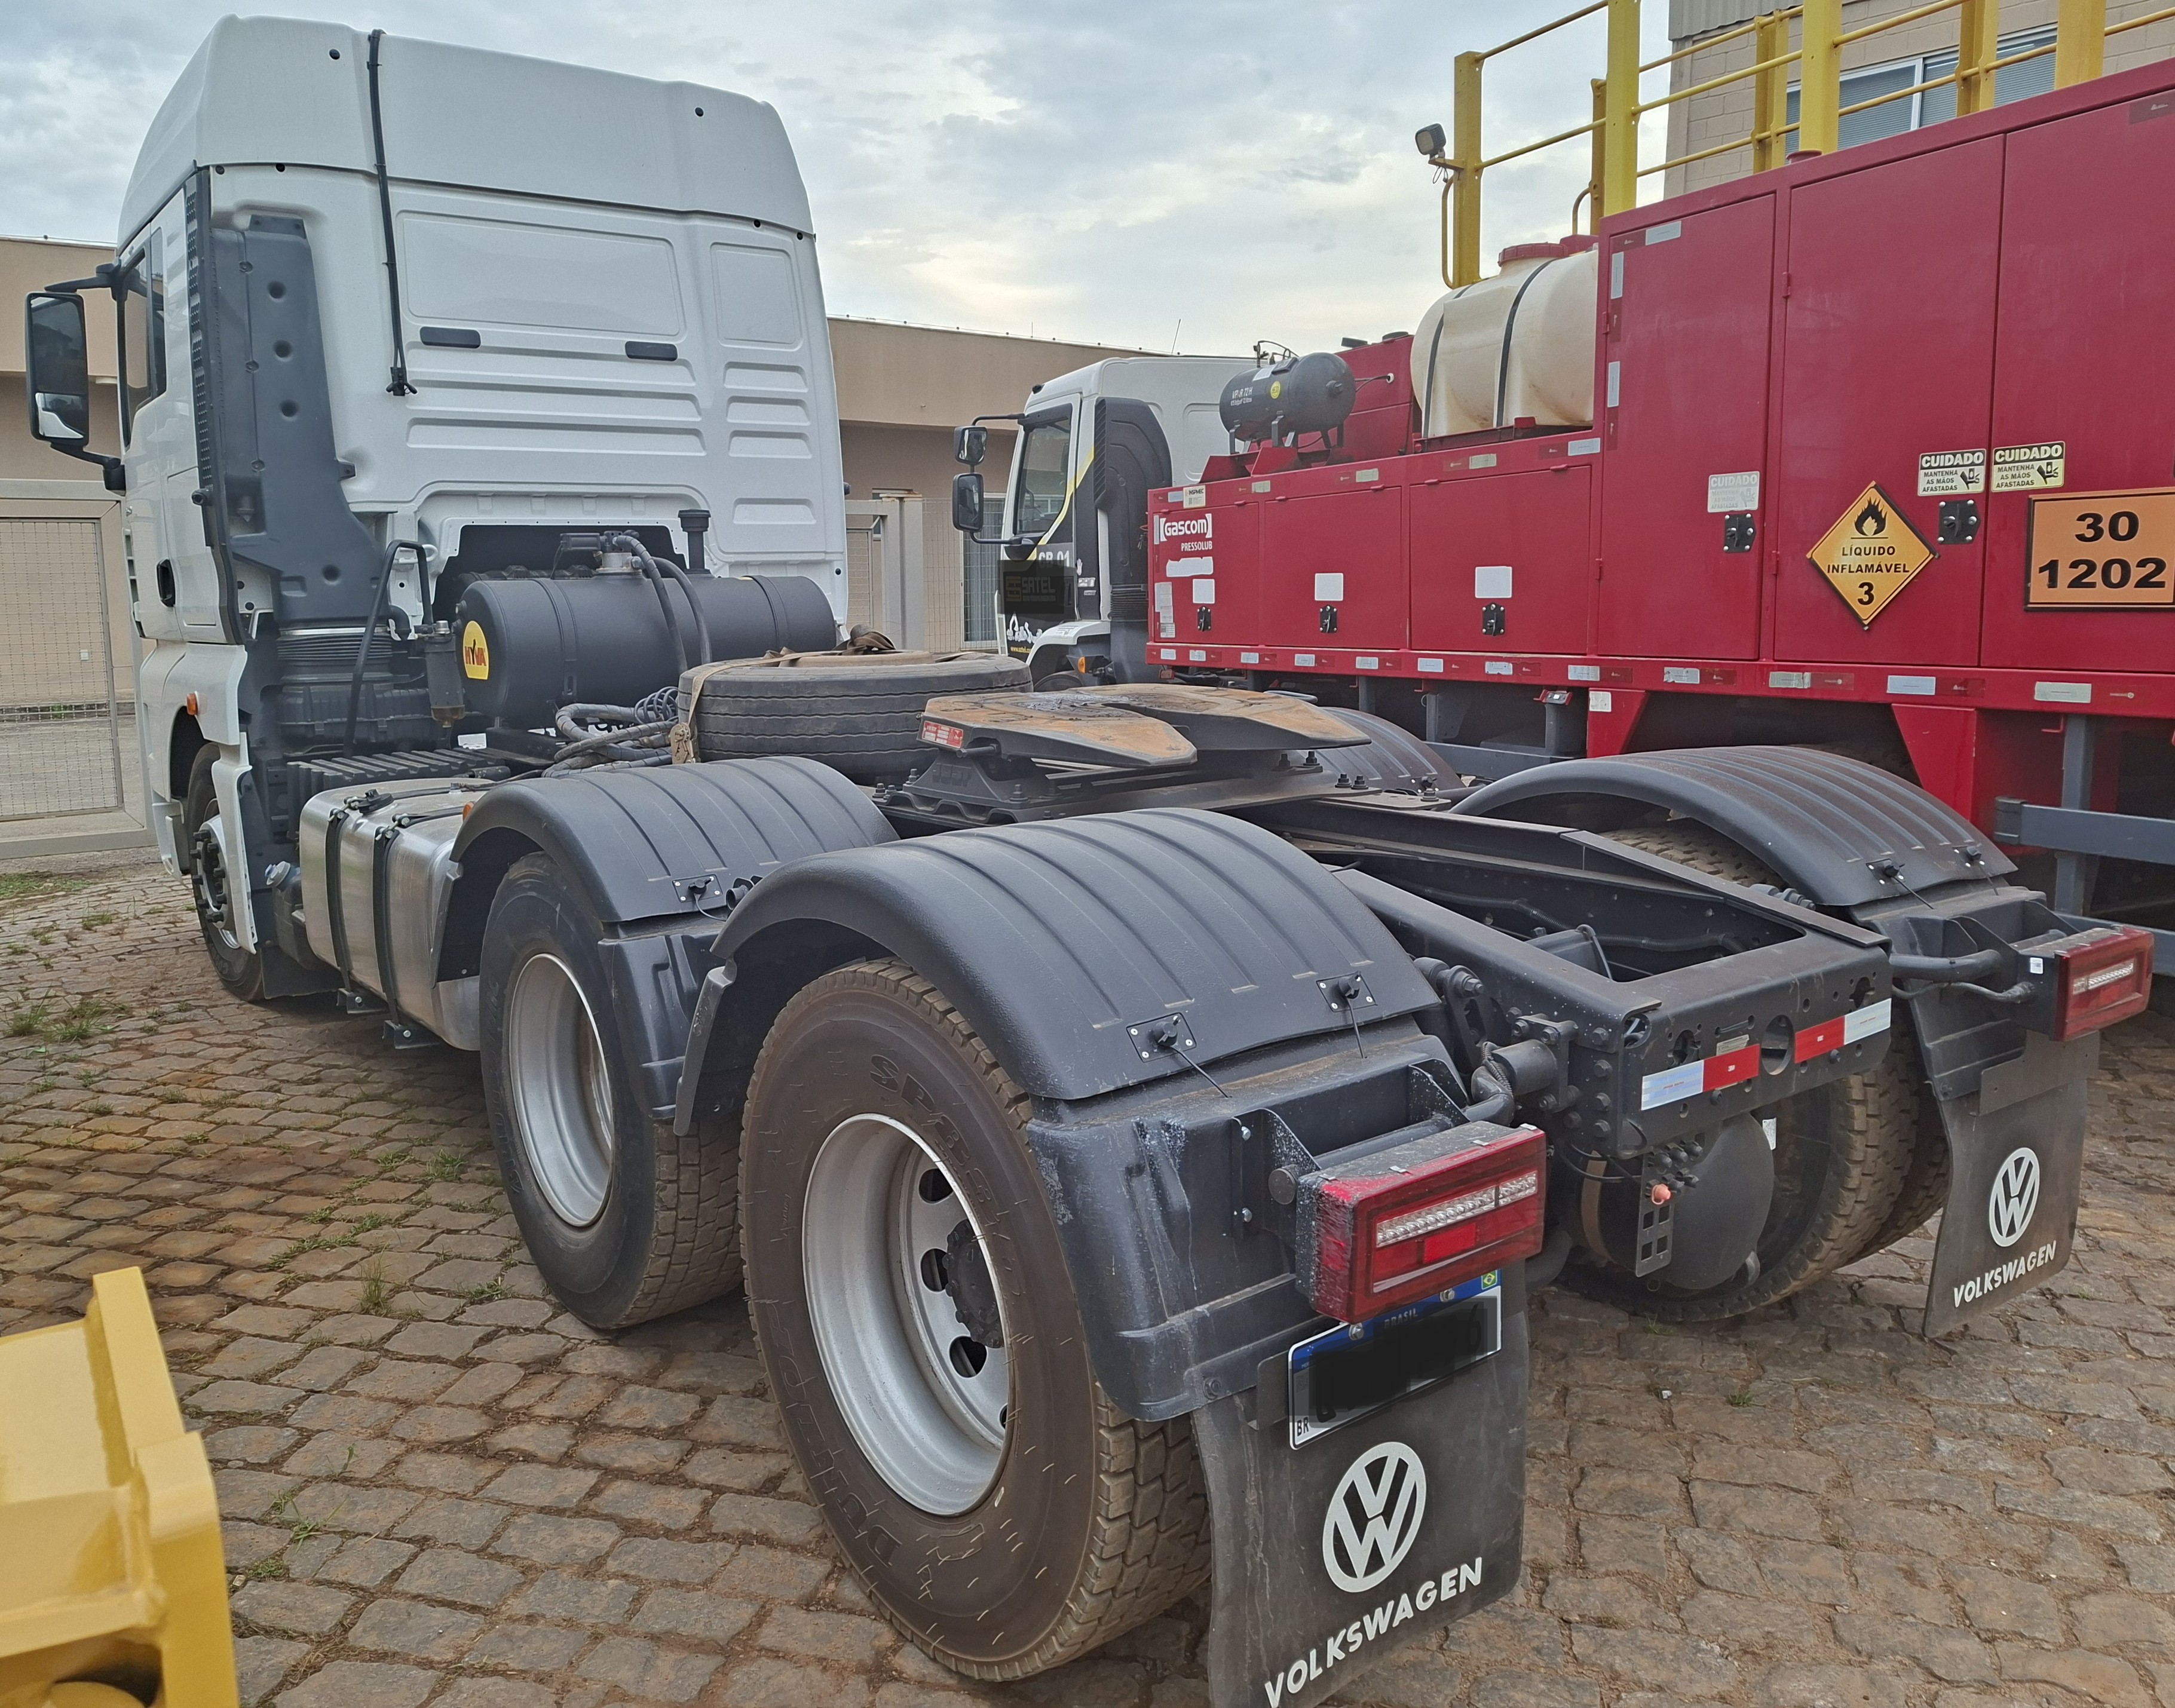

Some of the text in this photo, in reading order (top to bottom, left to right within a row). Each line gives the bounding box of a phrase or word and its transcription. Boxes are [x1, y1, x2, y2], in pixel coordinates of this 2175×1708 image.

[1922, 452, 1984, 467] CUIDADO
[1995, 444, 2063, 463] CUIDADO
[1923, 469, 1958, 477] MANTENHA
[1998, 464, 2035, 473] MANTENHA
[2010, 471, 2031, 479] MÃOS
[1711, 474, 1757, 487] CUIDADO
[1996, 479, 2035, 489] AFASTADAS
[2075, 511, 2139, 542] 30
[1181, 541, 1212, 552] PRESSOLUB
[1842, 544, 1896, 556] LÍQUIDO
[1827, 561, 1910, 574] INFLAMÁVEL
[2038, 557, 2167, 589] 1202
[1857, 581, 1875, 606] 3
[464, 639, 486, 666] HYVA
[1953, 1240, 2057, 1308] VOLKSWAGEN
[1384, 1307, 1419, 1330] BRASIL
[1296, 1416, 1310, 1437] BR
[1264, 1556, 1482, 1708] VOLKSWAGEN
